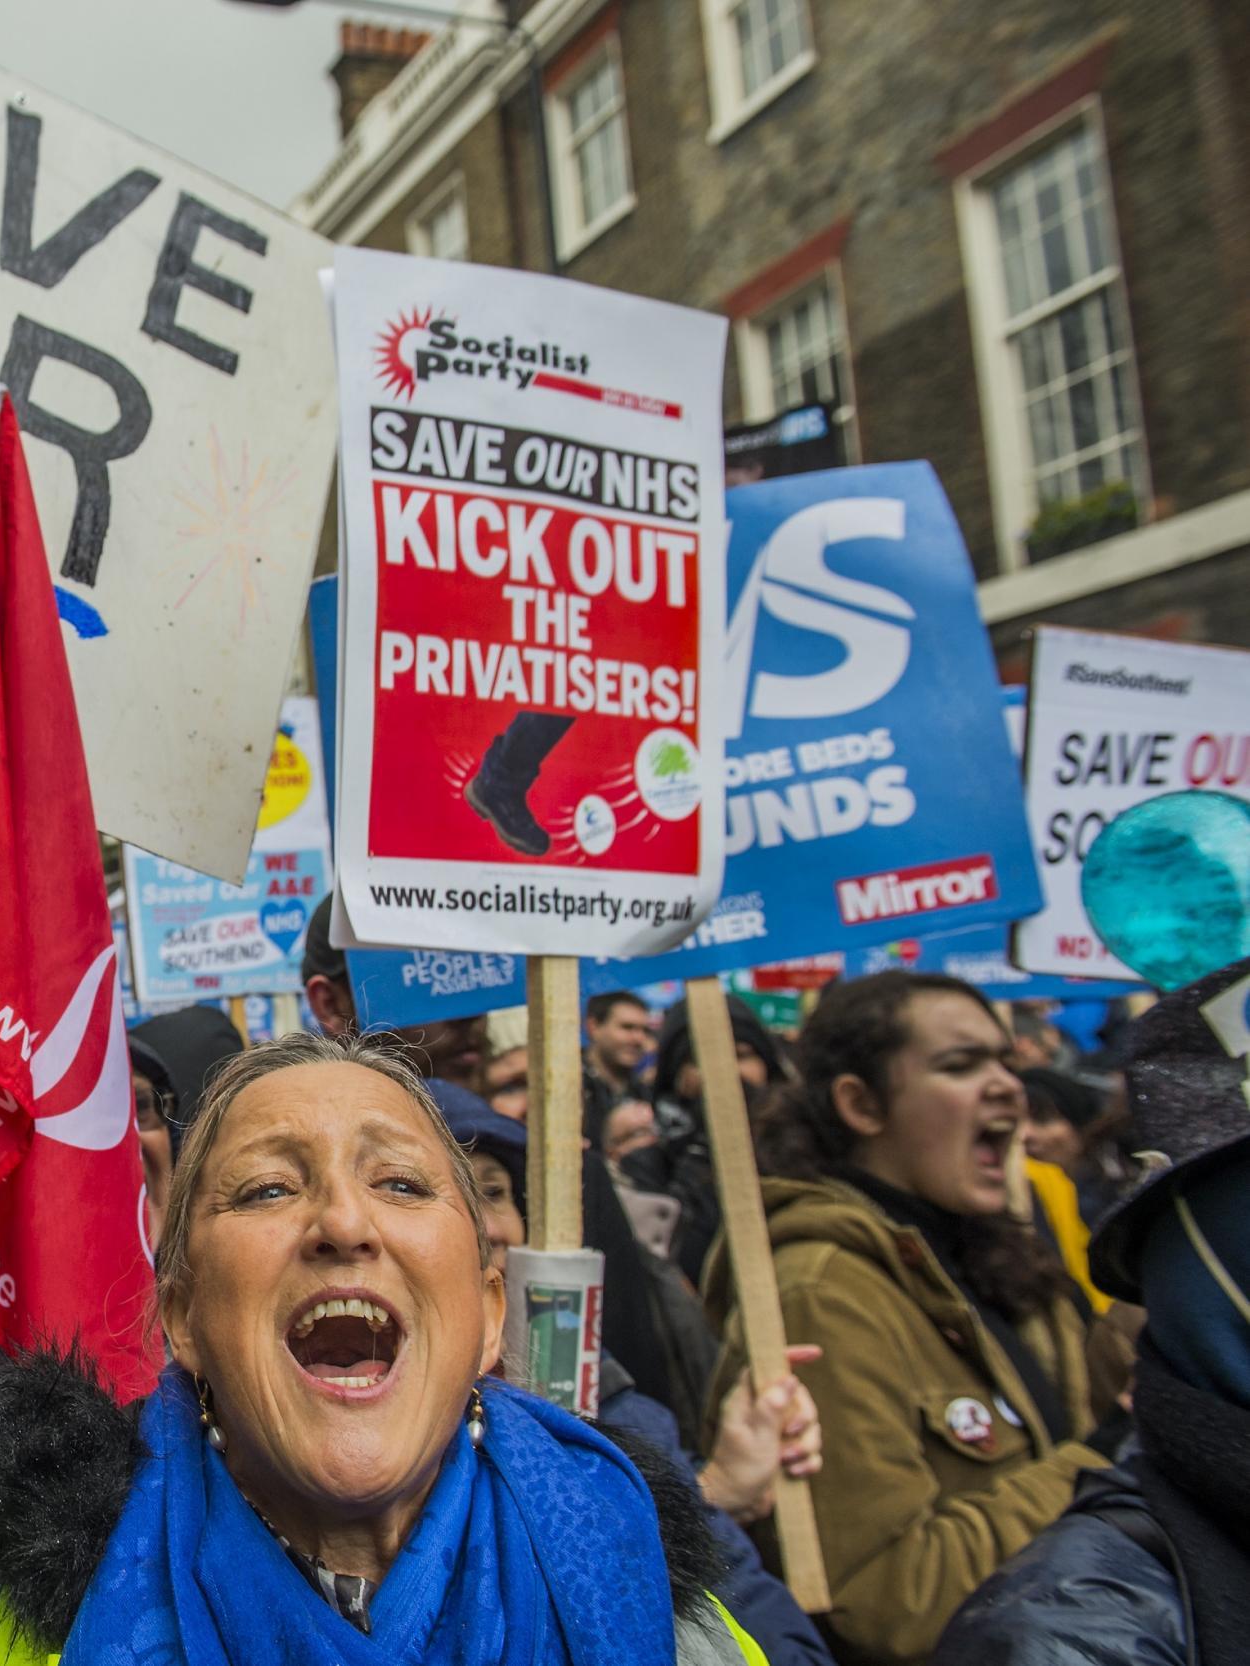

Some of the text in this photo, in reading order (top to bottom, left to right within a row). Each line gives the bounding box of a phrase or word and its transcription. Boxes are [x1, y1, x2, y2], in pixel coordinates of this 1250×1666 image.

[428, 318, 590, 376] Socialist
[371, 410, 700, 522] SAVE OUR NHS
[380, 486, 696, 607] KICK OUT
[502, 585, 592, 651] THE
[380, 630, 696, 725] PRIVATISERS!
[724, 728, 895, 788] ORE BEDS
[1055, 731, 1250, 787] SAVE OU
[724, 765, 916, 856] UNDS
[264, 853, 297, 872] WE
[265, 910, 303, 933] NHS
[370, 884, 696, 927] www.socialistparty.org.uk
[839, 865, 992, 923] Mirror
[217, 916, 258, 940] OUR
